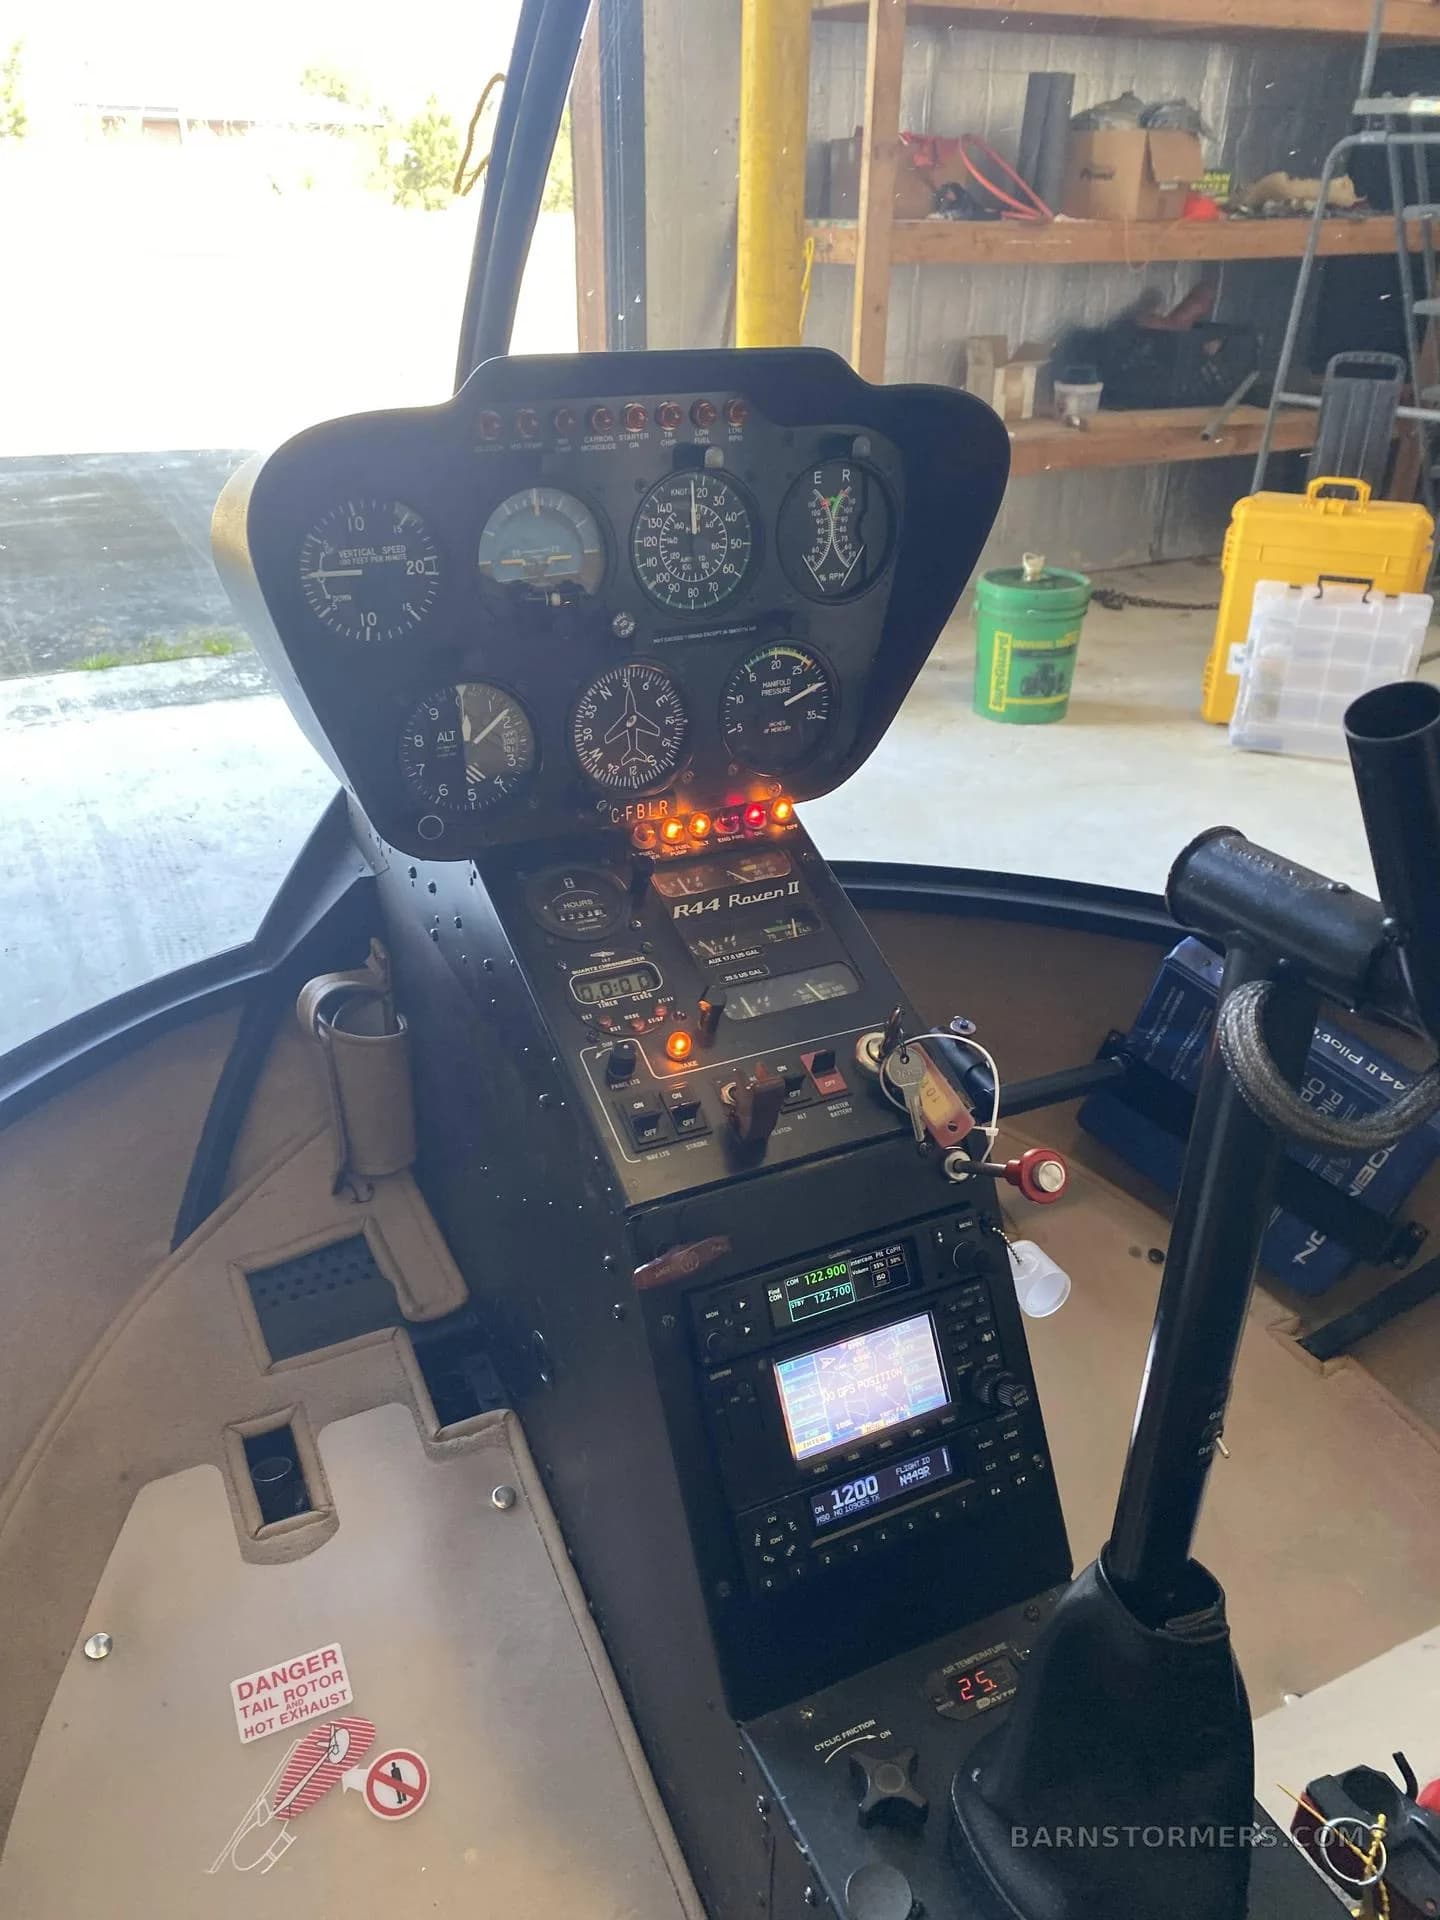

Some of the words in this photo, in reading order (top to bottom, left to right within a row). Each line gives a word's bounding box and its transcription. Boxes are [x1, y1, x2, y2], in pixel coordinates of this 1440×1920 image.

[584, 435, 614, 444] CARBON
[618, 432, 649, 441] STARTER
[814, 470, 823, 485] E
[842, 468, 851, 481] R
[671, 487, 690, 497] KNOT
[696, 487, 708, 498] 20
[713, 495, 725, 506] 30
[657, 502, 673, 514] 140
[647, 517, 663, 528] 130
[725, 512, 738, 522] 40
[347, 516, 365, 532] 10
[393, 524, 403, 535] 15
[643, 538, 658, 548] 120
[730, 538, 743, 549] 50
[338, 547, 377, 559] VERTICAL
[382, 544, 407, 555] SPEED
[646, 556, 658, 567] 110
[406, 560, 425, 576] 20
[722, 563, 735, 574] 60
[655, 573, 671, 583] 100
[829, 573, 845, 581] RPM
[668, 582, 680, 593] 90
[688, 586, 700, 598] 80
[708, 582, 719, 592] 70
[360, 611, 377, 627] 10
[771, 661, 782, 670] 20
[792, 665, 803, 676] 25
[749, 672, 758, 683] 15
[642, 681, 649, 691] 6
[762, 678, 792, 689] MANIFOLD
[600, 686, 613, 700] N
[761, 686, 792, 697] PRESSURE
[655, 694, 669, 708] E
[735, 694, 744, 704] 10
[428, 707, 440, 720] 9
[584, 704, 598, 719] 33
[807, 709, 818, 720] 35
[664, 716, 675, 725] 12
[736, 723, 744, 733] 5
[436, 730, 457, 743] ALT
[582, 727, 593, 741] 30
[413, 734, 424, 748] 8
[661, 737, 672, 748] 15
[506, 753, 517, 767] 3
[647, 754, 657, 767] S
[415, 763, 426, 776] 7
[494, 775, 504, 786] 4
[438, 783, 449, 796] 6
[467, 788, 477, 801] 5
[611, 800, 668, 823] C-FBLR
[563, 898, 594, 909] HOURS
[673, 897, 720, 919] R44
[728, 888, 784, 909] Raven
[788, 879, 800, 897] II
[707, 957, 723, 966] AUX
[746, 947, 760, 957] GAL
[571, 964, 598, 975] QUARTZ
[749, 968, 763, 978] GAL
[631, 992, 653, 1001] CLOCK
[598, 999, 619, 1009] TIMER
[632, 1101, 645, 1110] ON
[826, 1101, 850, 1112] MASTER
[829, 1107, 853, 1119] BATTERY
[958, 1219, 974, 1229] MENU
[802, 1262, 847, 1287] 122.900
[786, 1277, 800, 1287] COM
[768, 1292, 783, 1303] COM
[790, 1300, 805, 1310] STBY
[813, 1283, 852, 1305] 122.700
[704, 1309, 720, 1320] MON
[823, 1387, 836, 1402] NO
[838, 1381, 856, 1397] GPS
[857, 1366, 904, 1391] POSITION
[896, 1461, 920, 1476] FLIGHT
[984, 1461, 998, 1472] CLR
[899, 1466, 932, 1489] N449R
[832, 1475, 880, 1511] 1200
[814, 1505, 825, 1515] ON
[833, 1508, 844, 1518] NO
[844, 1499, 870, 1516] 1090ES
[768, 1514, 777, 1525] ON
[942, 1663, 956, 1676] AIR
[954, 1641, 1009, 1670] TEMPERATURE
[237, 1649, 338, 1701] DANGER
[239, 1696, 280, 1719] TAIL
[283, 1669, 344, 1704] ROTOR
[286, 1698, 305, 1711] AND
[244, 1716, 275, 1739] HOT
[280, 1689, 348, 1725] EXHAUST
[814, 1734, 842, 1752] CYCLIC
[841, 1719, 877, 1741] FRICTION
[879, 1729, 892, 1740] ON
